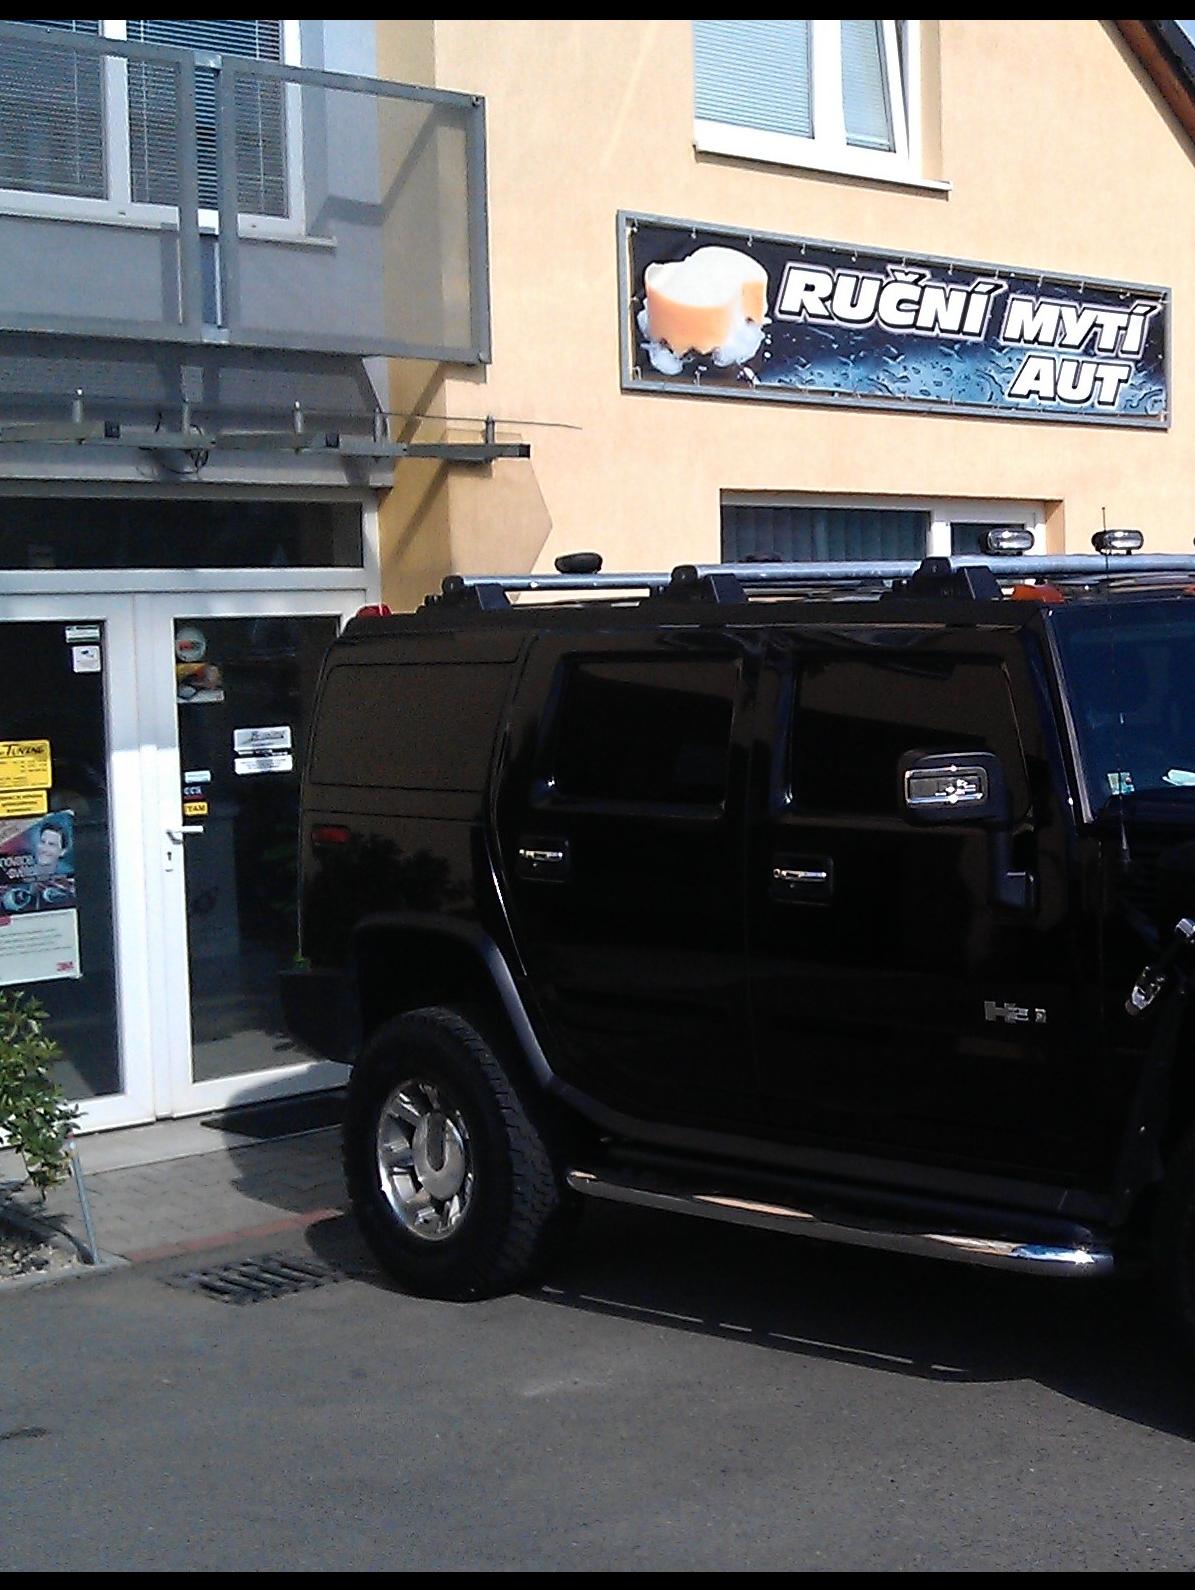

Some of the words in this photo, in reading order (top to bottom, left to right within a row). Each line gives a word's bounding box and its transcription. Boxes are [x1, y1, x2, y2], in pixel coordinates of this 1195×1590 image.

[779, 265, 1004, 338] RUČNÍ
[1002, 298, 1159, 356] MYTÍ
[1008, 355, 1133, 407] AUT
[984, 1000, 1029, 1023] H2
